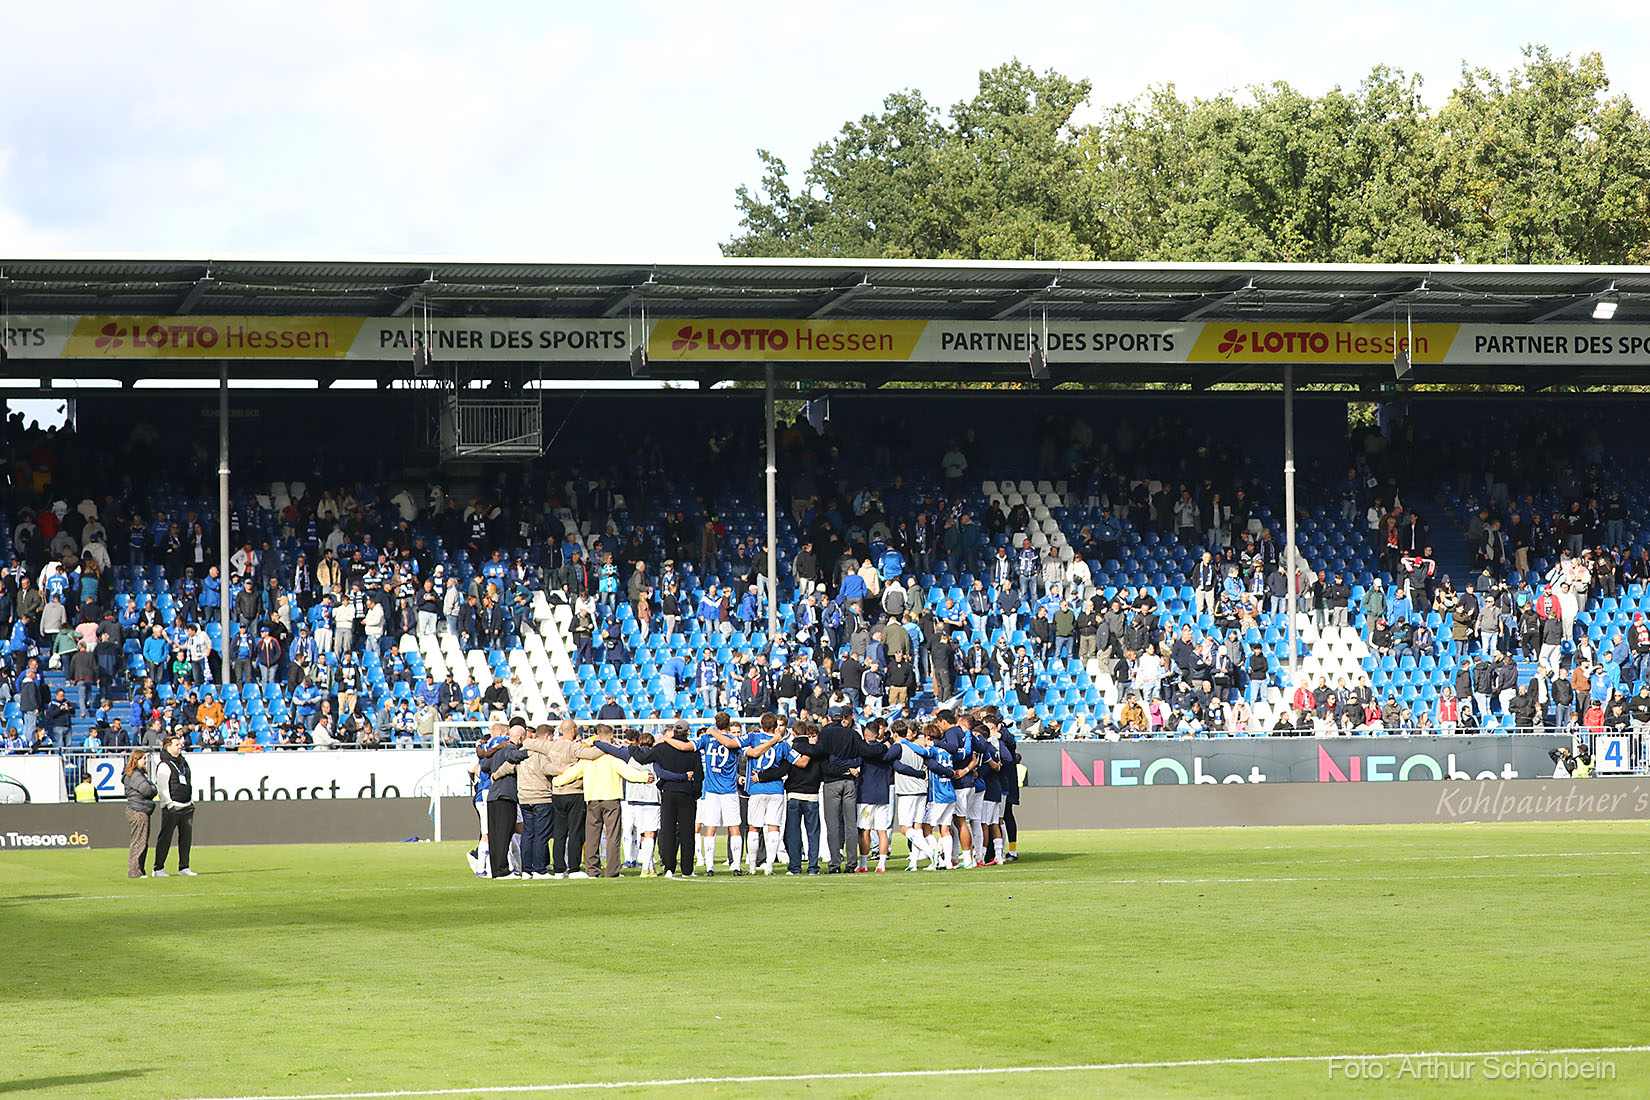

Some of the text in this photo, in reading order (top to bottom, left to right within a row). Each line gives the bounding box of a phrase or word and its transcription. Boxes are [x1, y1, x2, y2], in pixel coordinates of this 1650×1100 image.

[0, 328, 45, 346] RTS
[132, 326, 329, 349] LOTTO Hessen
[380, 330, 626, 350] PARTNER DES SPORTS
[708, 328, 893, 351] LOTTO Hessen
[942, 332, 1174, 352] PARTNER DES SPORTS
[1252, 331, 1428, 353] LOTTO Hessen
[1475, 335, 1568, 354] PARTNER
[1574, 336, 1613, 354] DES
[706, 743, 729, 768] 49
[1605, 740, 1623, 767] 4
[96, 762, 115, 791] 2
[6, 831, 89, 847] Tresore.de
